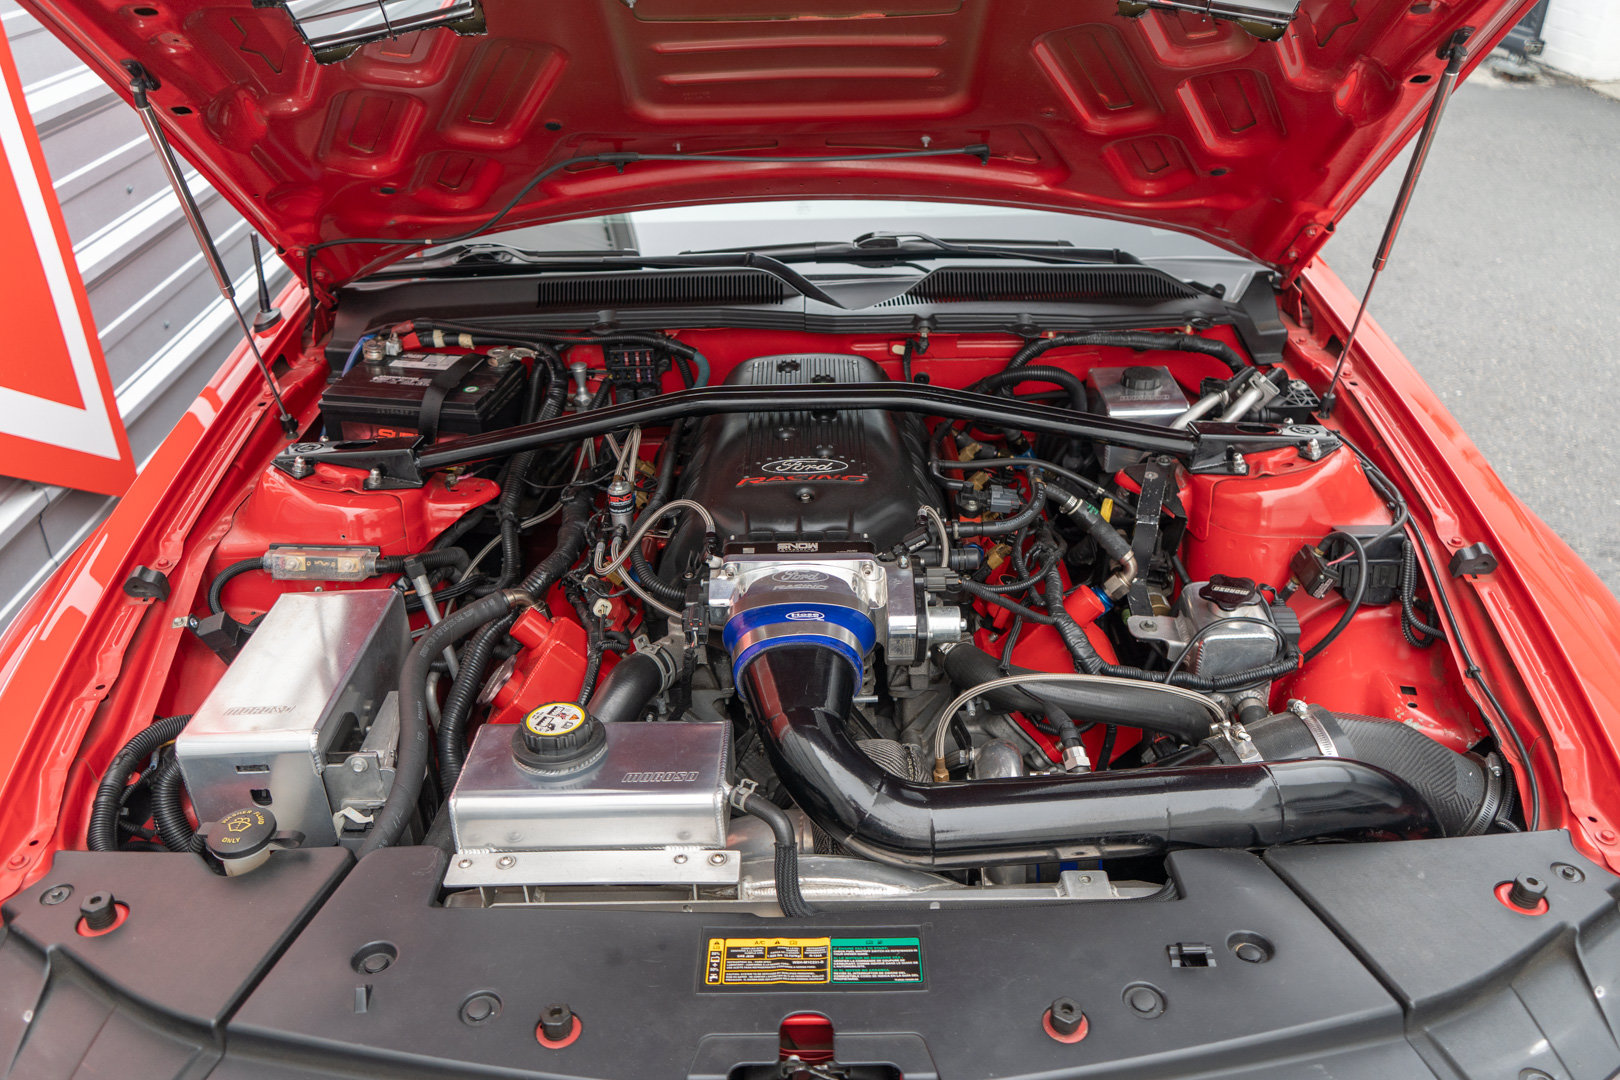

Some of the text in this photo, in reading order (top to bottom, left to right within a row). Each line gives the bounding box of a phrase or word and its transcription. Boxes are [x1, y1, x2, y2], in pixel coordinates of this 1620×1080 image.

[775, 459, 832, 472] Ford
[736, 474, 868, 487] RACING
[781, 569, 819, 580] Ford
[621, 771, 699, 782] MOROSO
[221, 810, 265, 825] WASHER FLUID
